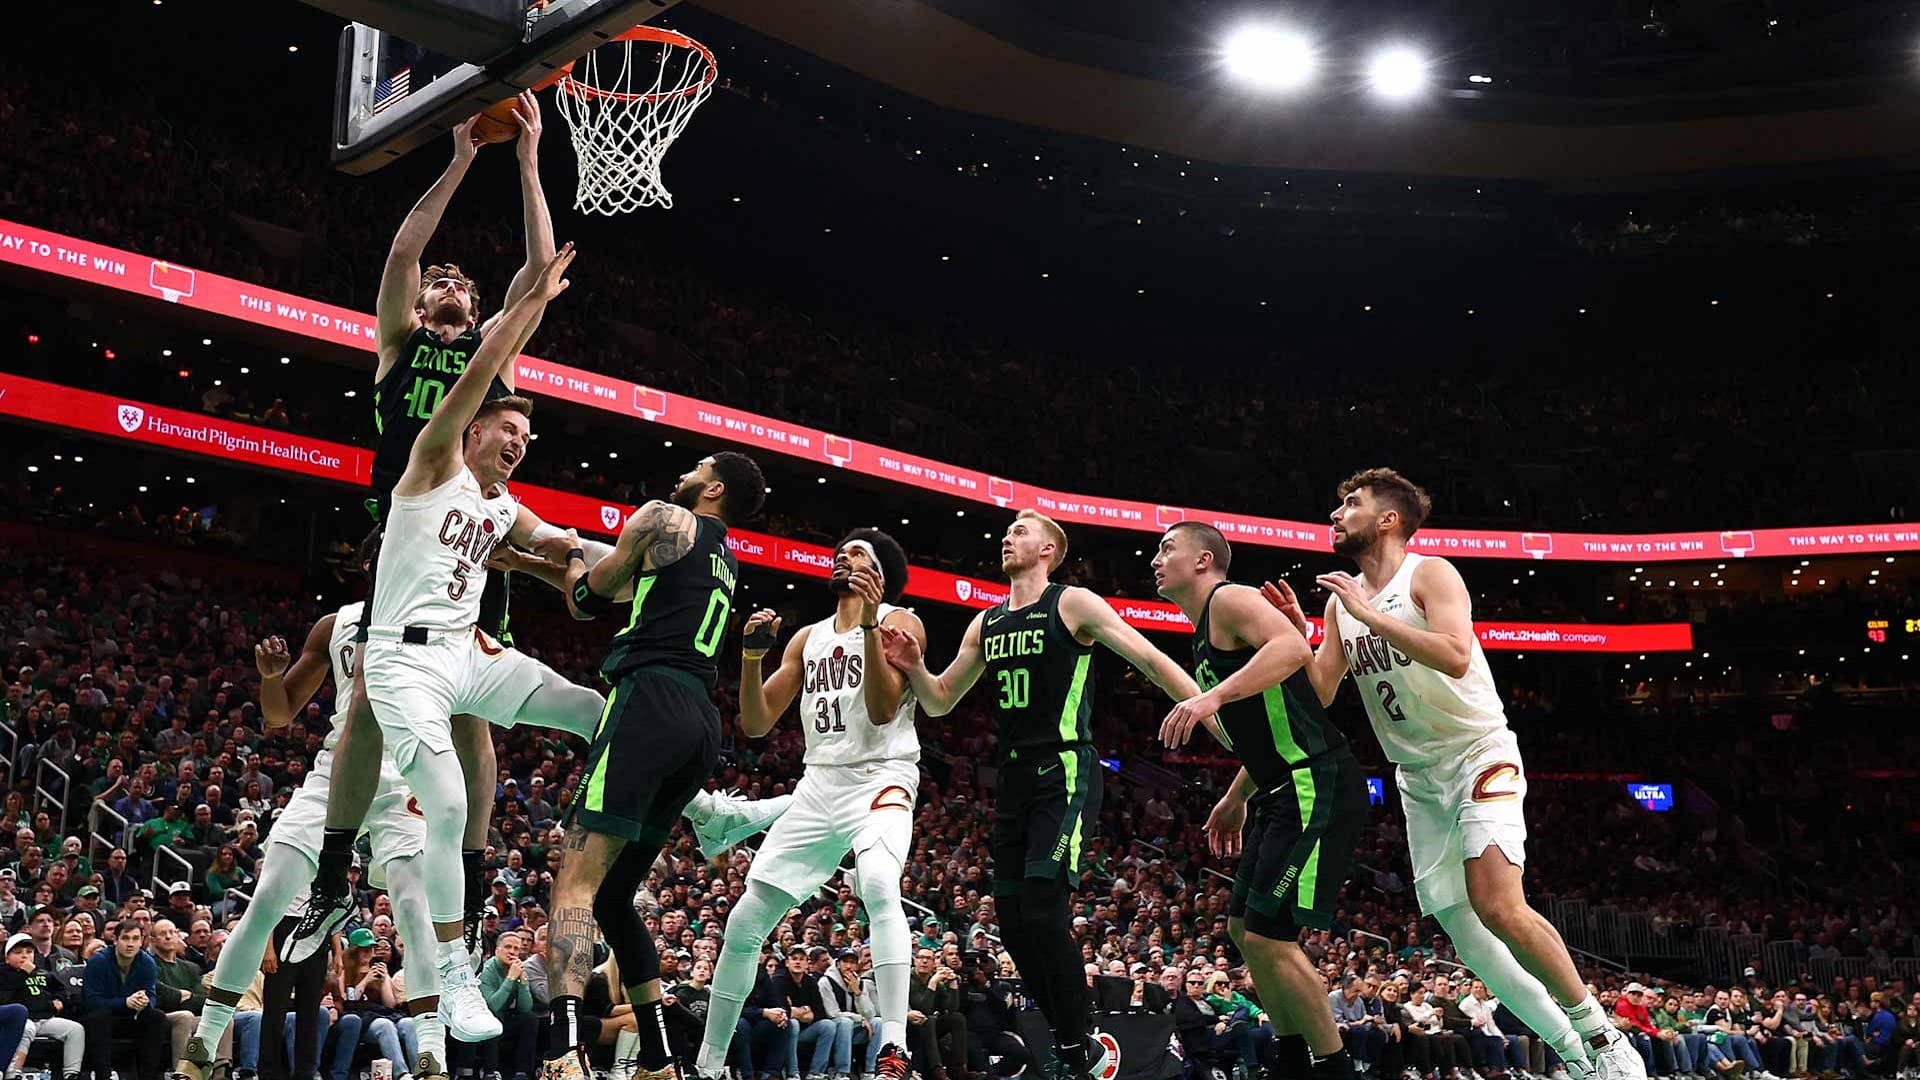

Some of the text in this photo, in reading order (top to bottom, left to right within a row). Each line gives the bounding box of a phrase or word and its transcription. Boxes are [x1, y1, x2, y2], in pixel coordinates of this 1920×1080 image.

[29, 241, 51, 257] TO
[57, 248, 88, 266] THE
[93, 257, 126, 275] WIN
[240, 294, 272, 312] THIS
[276, 304, 307, 321] WAY
[311, 313, 330, 327] TO
[334, 319, 360, 335] THE
[518, 366, 617, 400] WAY TO THE WIN
[148, 416, 340, 468] Harvard Pilgrim Health Care
[697, 411, 810, 448] THIS WAY TO THE WIN
[879, 457, 977, 490] THIS WAY TO THE WIN
[1037, 496, 1142, 520] THIS WAY TO THE WIN
[1213, 520, 1316, 541] THIS WAY TO THE WIN
[1419, 537, 1441, 547] WAY
[1444, 538, 1458, 548] TO
[1461, 539, 1481, 548] THE
[1485, 540, 1507, 549] WIN
[1584, 540, 1704, 552] THIS WAY TO THE WIN
[1789, 531, 1918, 546] THIS WAY TO THE WIN
[740, 540, 764, 555] Care
[784, 551, 791, 560] a
[447, 560, 471, 601] 5
[710, 553, 737, 596] TATUM
[694, 587, 730, 657] 0
[1562, 633, 1606, 645] company
[984, 629, 1044, 662] CELTICS
[803, 655, 862, 693] CAVS
[997, 668, 1030, 709] 30
[815, 696, 846, 734] 31
[1376, 680, 1406, 722] 2
[1634, 791, 1666, 800] ULTRA
[1051, 833, 1070, 862] BOSTON
[1272, 864, 1299, 898] BOSTON
